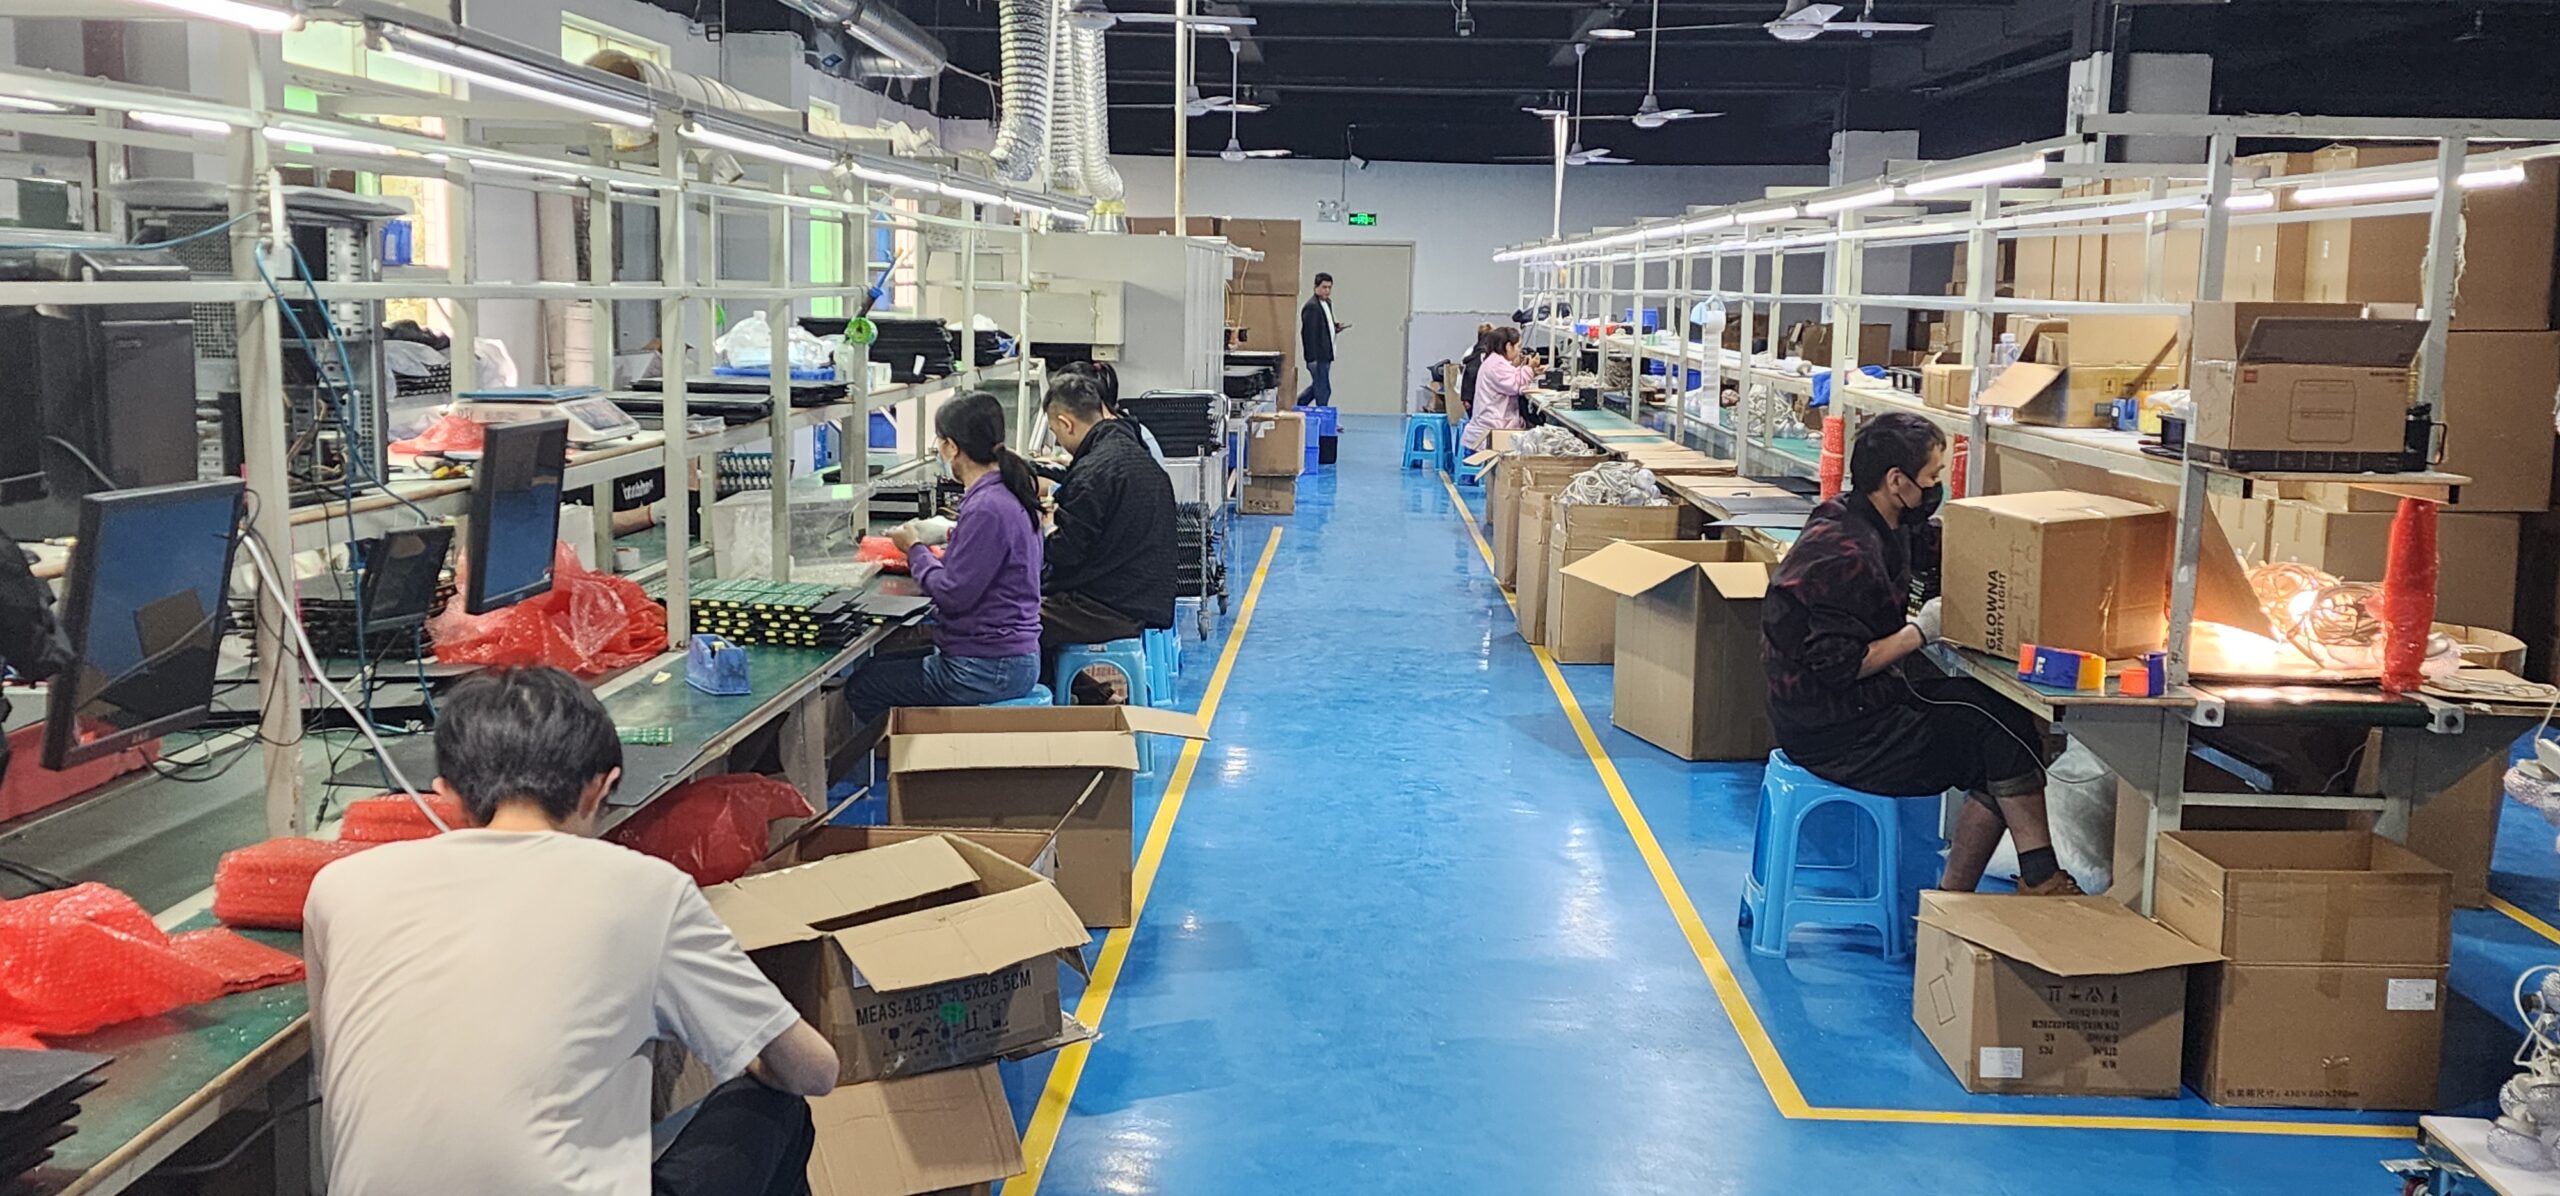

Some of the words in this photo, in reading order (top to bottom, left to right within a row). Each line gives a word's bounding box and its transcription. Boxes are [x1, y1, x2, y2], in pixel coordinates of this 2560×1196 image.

[1986, 569, 1998, 650] GLOWNA
[1998, 573, 2007, 611] LIGHT
[1996, 612, 2005, 652] PARTY
